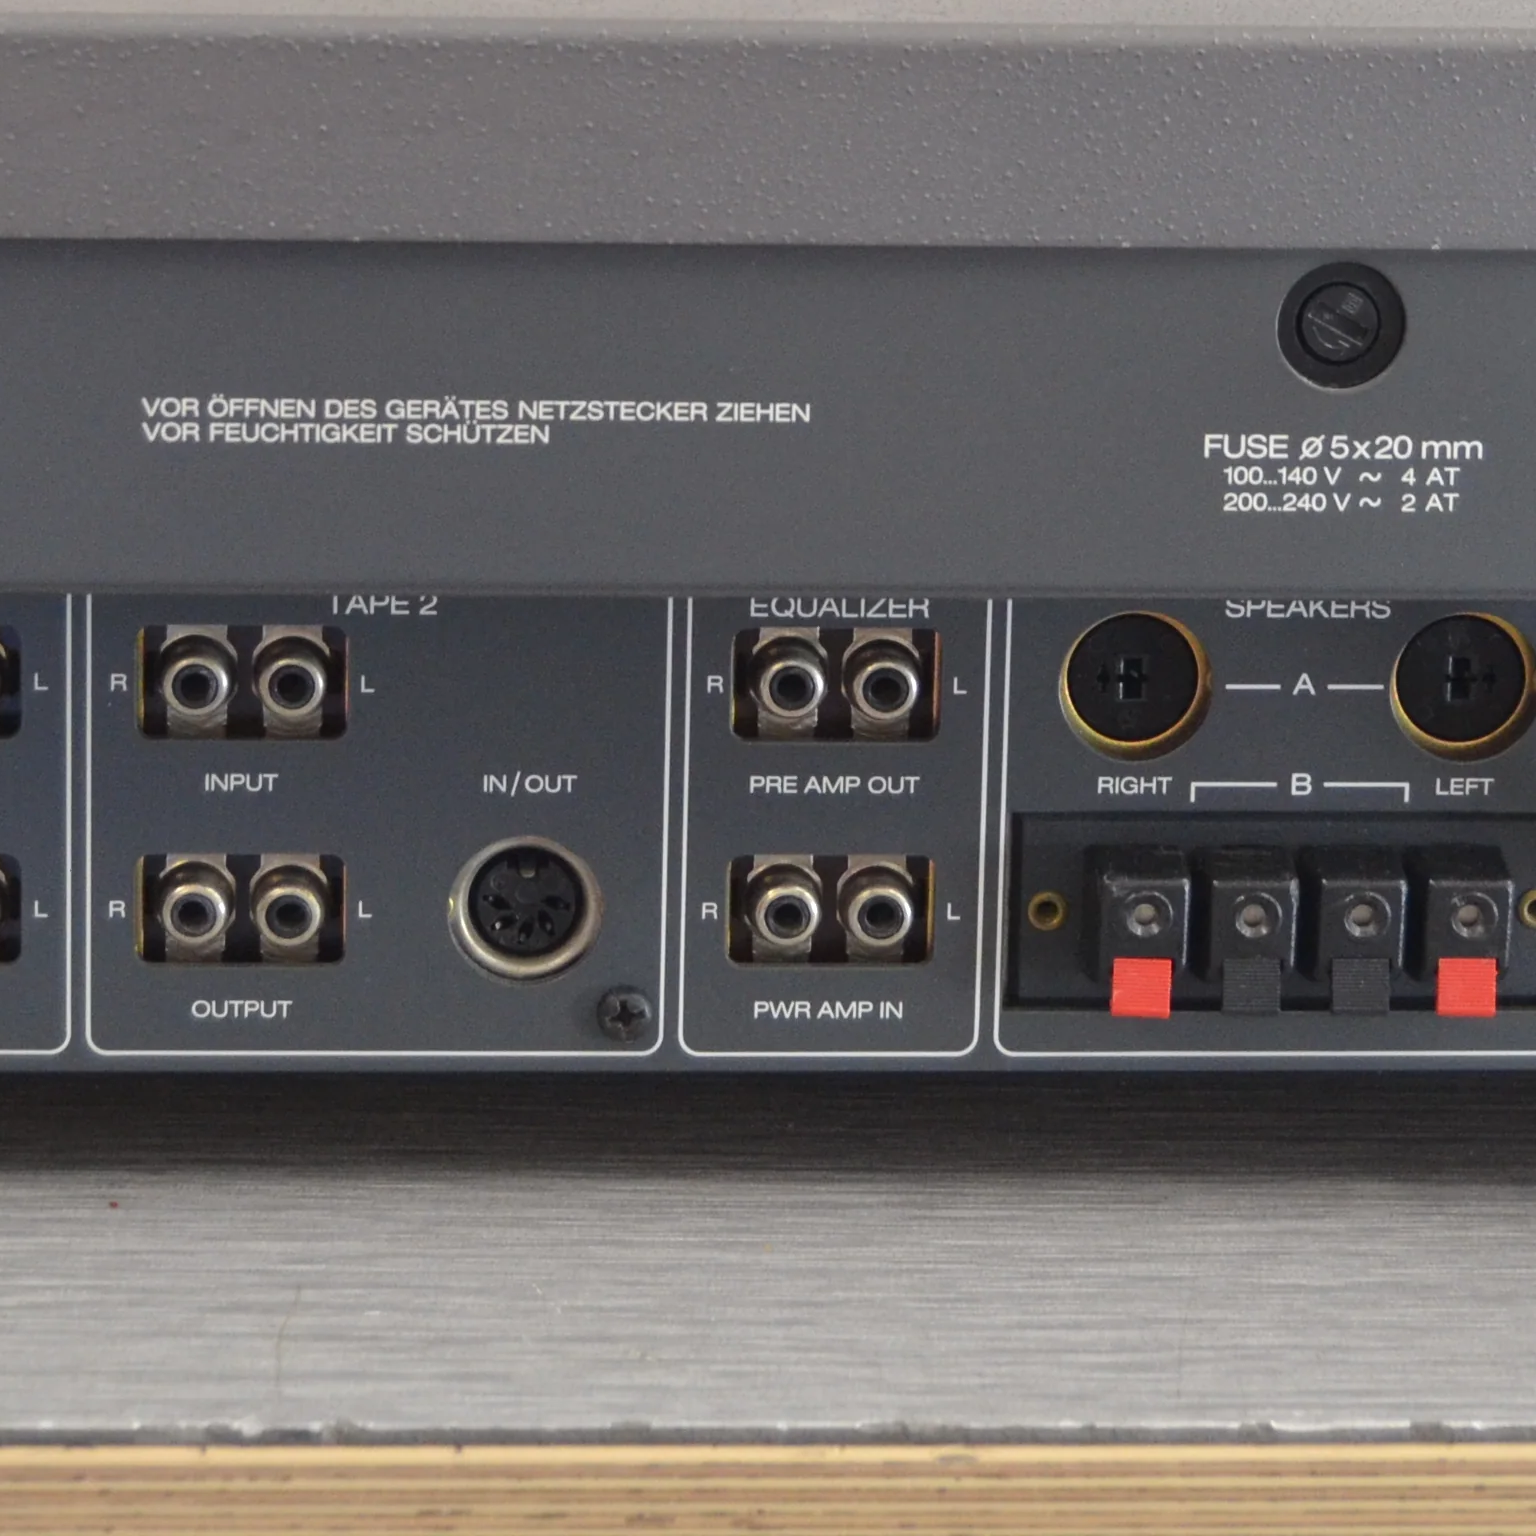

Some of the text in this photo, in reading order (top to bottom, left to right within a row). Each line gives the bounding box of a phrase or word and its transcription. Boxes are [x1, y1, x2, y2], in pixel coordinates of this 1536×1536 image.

[142, 394, 810, 422] VOR ÖFFNEN DES GERÄTES NETZSTECKER ZIEHEN
[142, 421, 549, 444] VOR FEUCHTIGKEIT SCHÜTZEN
[1204, 434, 1289, 459] FUSE
[1422, 441, 1483, 459] mm
[1324, 467, 1341, 485] V
[1401, 468, 1416, 486] 4
[1426, 467, 1460, 486] AT
[1333, 493, 1351, 511] V
[1401, 494, 1416, 512] 2
[1425, 493, 1459, 512] AT
[751, 598, 929, 618] EQUALIZER
[34, 673, 48, 690] L
[111, 674, 127, 691] R
[361, 675, 374, 693] L
[707, 675, 723, 693] R
[953, 677, 967, 694] L
[1293, 673, 1315, 695] A
[205, 774, 278, 791] INPUT
[750, 776, 920, 794] PRE AMP OUT
[1098, 777, 1172, 794] RIGHT
[1291, 773, 1312, 795] B
[1436, 778, 1494, 795] LEFT
[34, 900, 48, 918] L
[109, 900, 125, 918] R
[359, 900, 372, 918] L
[702, 902, 717, 919] R
[947, 903, 960, 920] L
[191, 1000, 292, 1018] OUTPUT
[754, 1001, 903, 1019] PWR AMP IN
